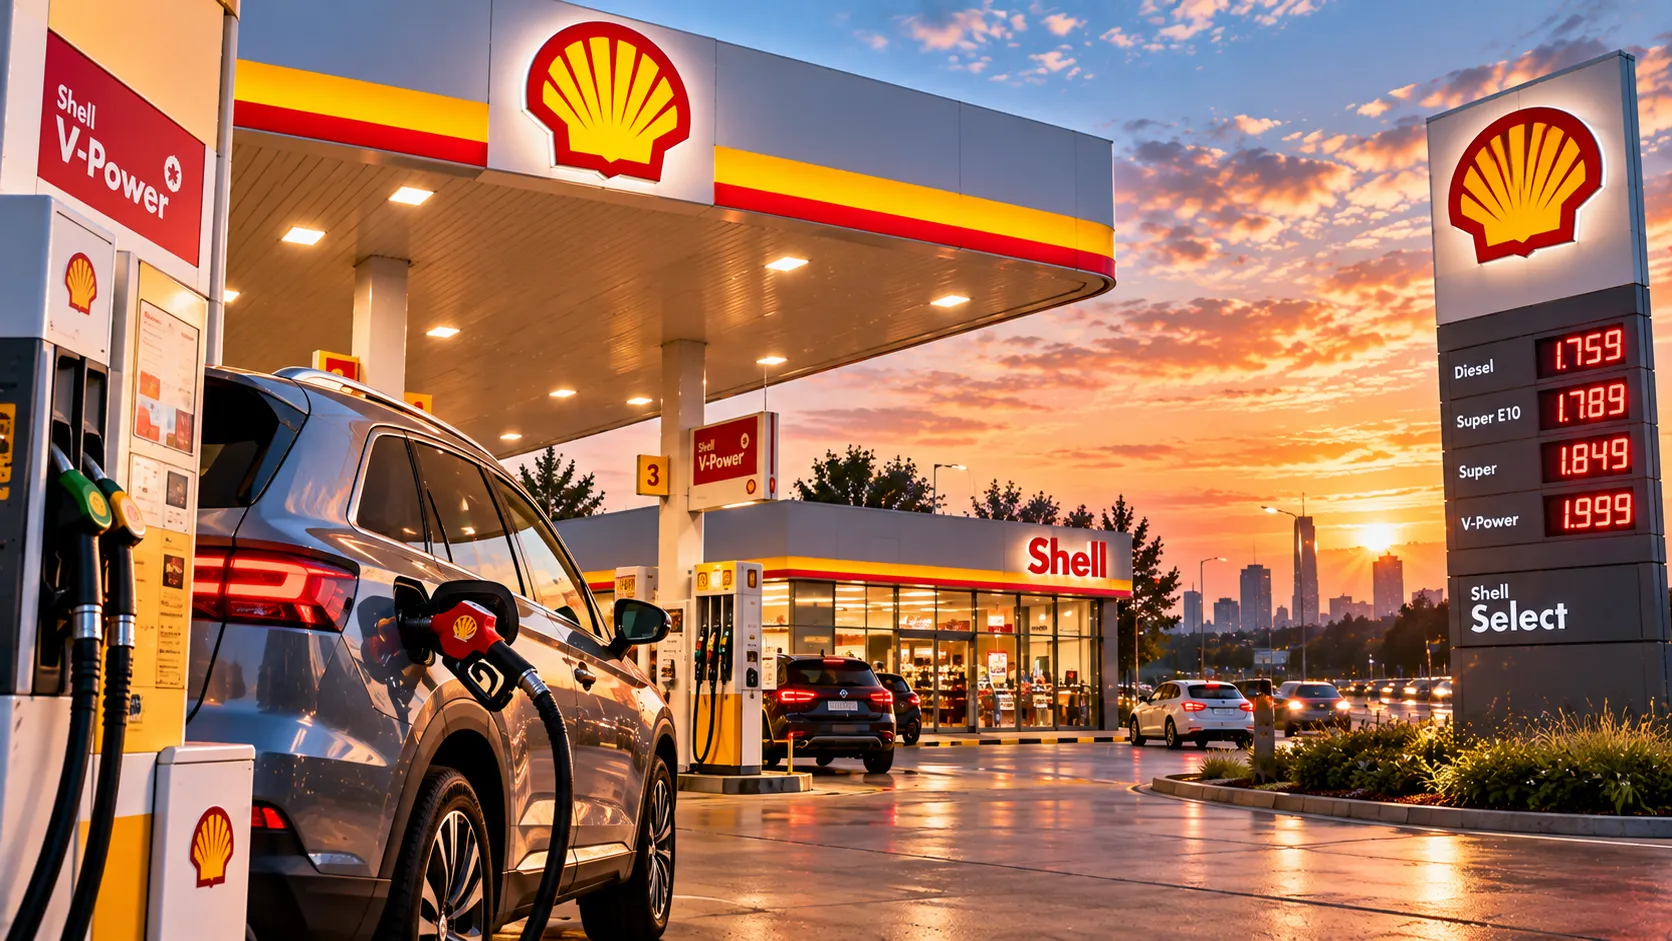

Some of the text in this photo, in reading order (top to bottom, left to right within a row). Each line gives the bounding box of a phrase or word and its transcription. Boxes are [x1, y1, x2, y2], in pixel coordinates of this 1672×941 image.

[57, 84, 96, 130] Shell
[56, 115, 169, 219] V-Power
[1454, 329, 1622, 380] Diesel 1.759
[1456, 383, 1625, 430] Super E10 1.789
[647, 463, 660, 486] 3
[698, 452, 744, 472] V-Power
[1459, 438, 1628, 481] Super 1.849
[1461, 493, 1632, 531] V-Power 1.999
[1028, 537, 1107, 578] Shell
[1471, 583, 1509, 601] Shell
[1471, 600, 1568, 633] Select
